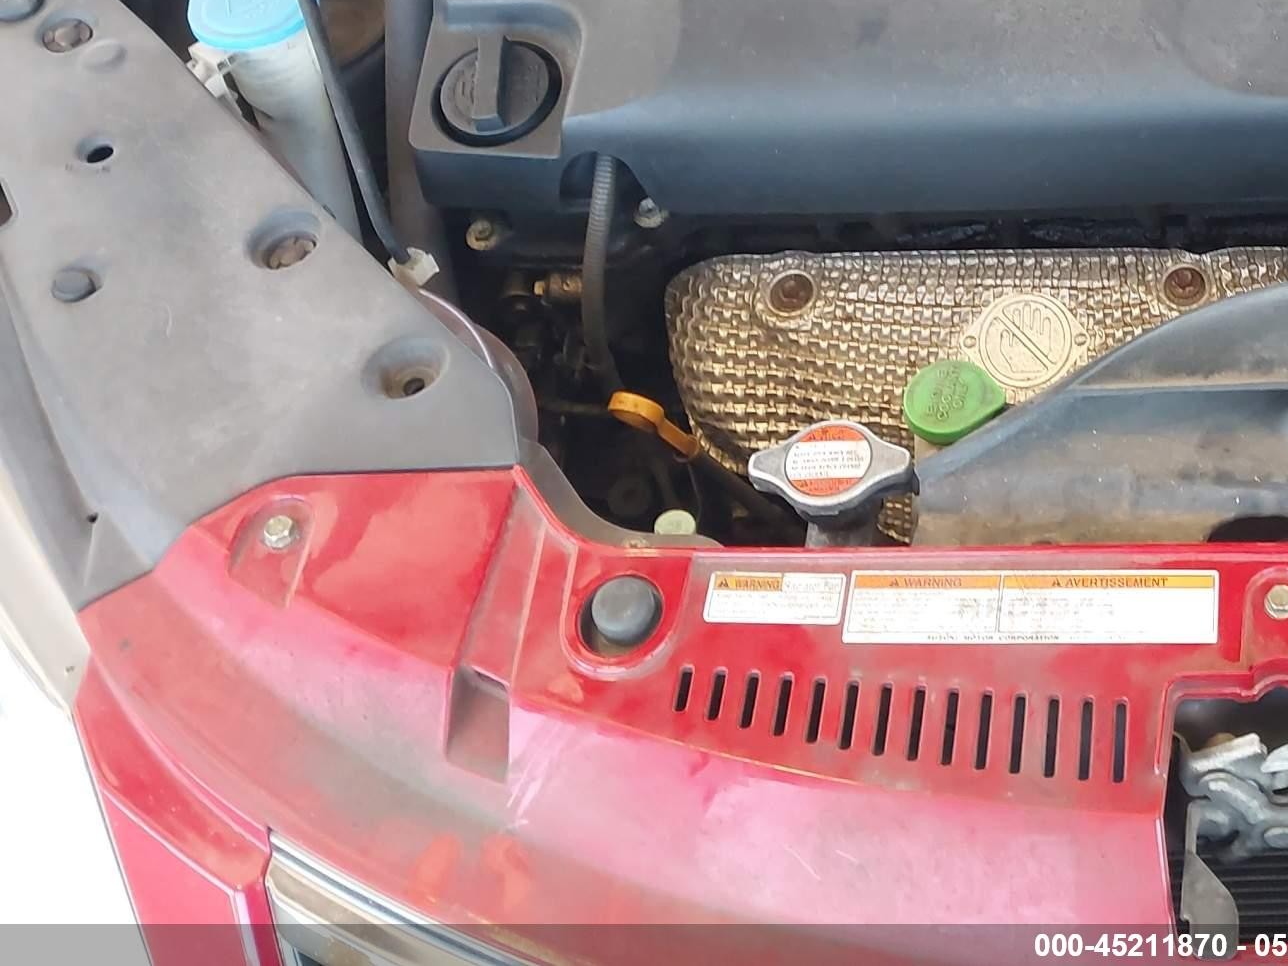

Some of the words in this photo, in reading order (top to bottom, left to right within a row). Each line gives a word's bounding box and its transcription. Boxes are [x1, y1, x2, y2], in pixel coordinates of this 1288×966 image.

[735, 576, 780, 589] WARNING
[903, 578, 962, 588] WARNING
[1064, 577, 1169, 588] AVERTISSEMENT
